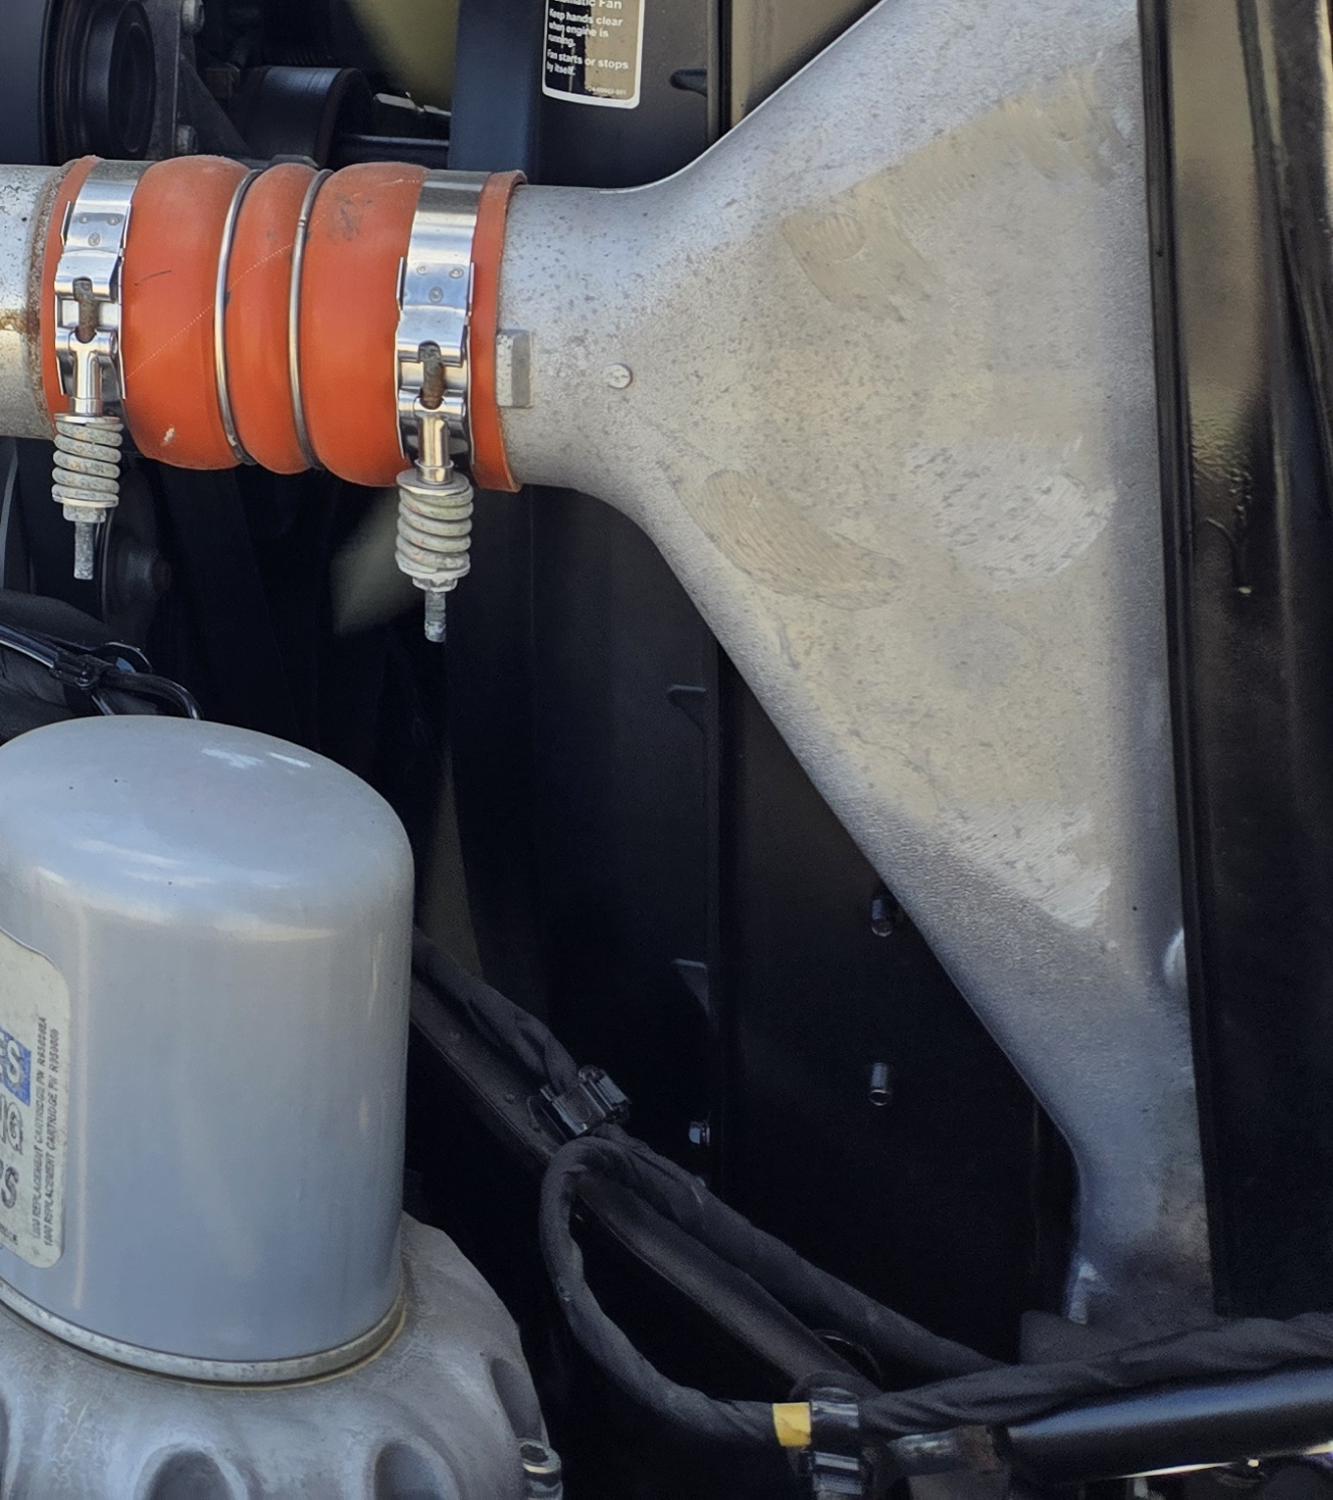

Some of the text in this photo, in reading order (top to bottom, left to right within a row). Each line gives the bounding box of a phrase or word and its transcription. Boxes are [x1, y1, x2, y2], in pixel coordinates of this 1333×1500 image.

[548, 21, 610, 38] when engine is
[549, 8, 624, 27] Keep hands clear
[545, 61, 554, 73] by
[546, 48, 629, 71] Fan starts or stops
[34, 1086, 46, 1145] CARTRIDGE
[45, 1093, 58, 1151] CARTRIDGE
[33, 1145, 44, 1215] REPLACEMENT
[44, 1152, 56, 1226] REPLACEMENT
